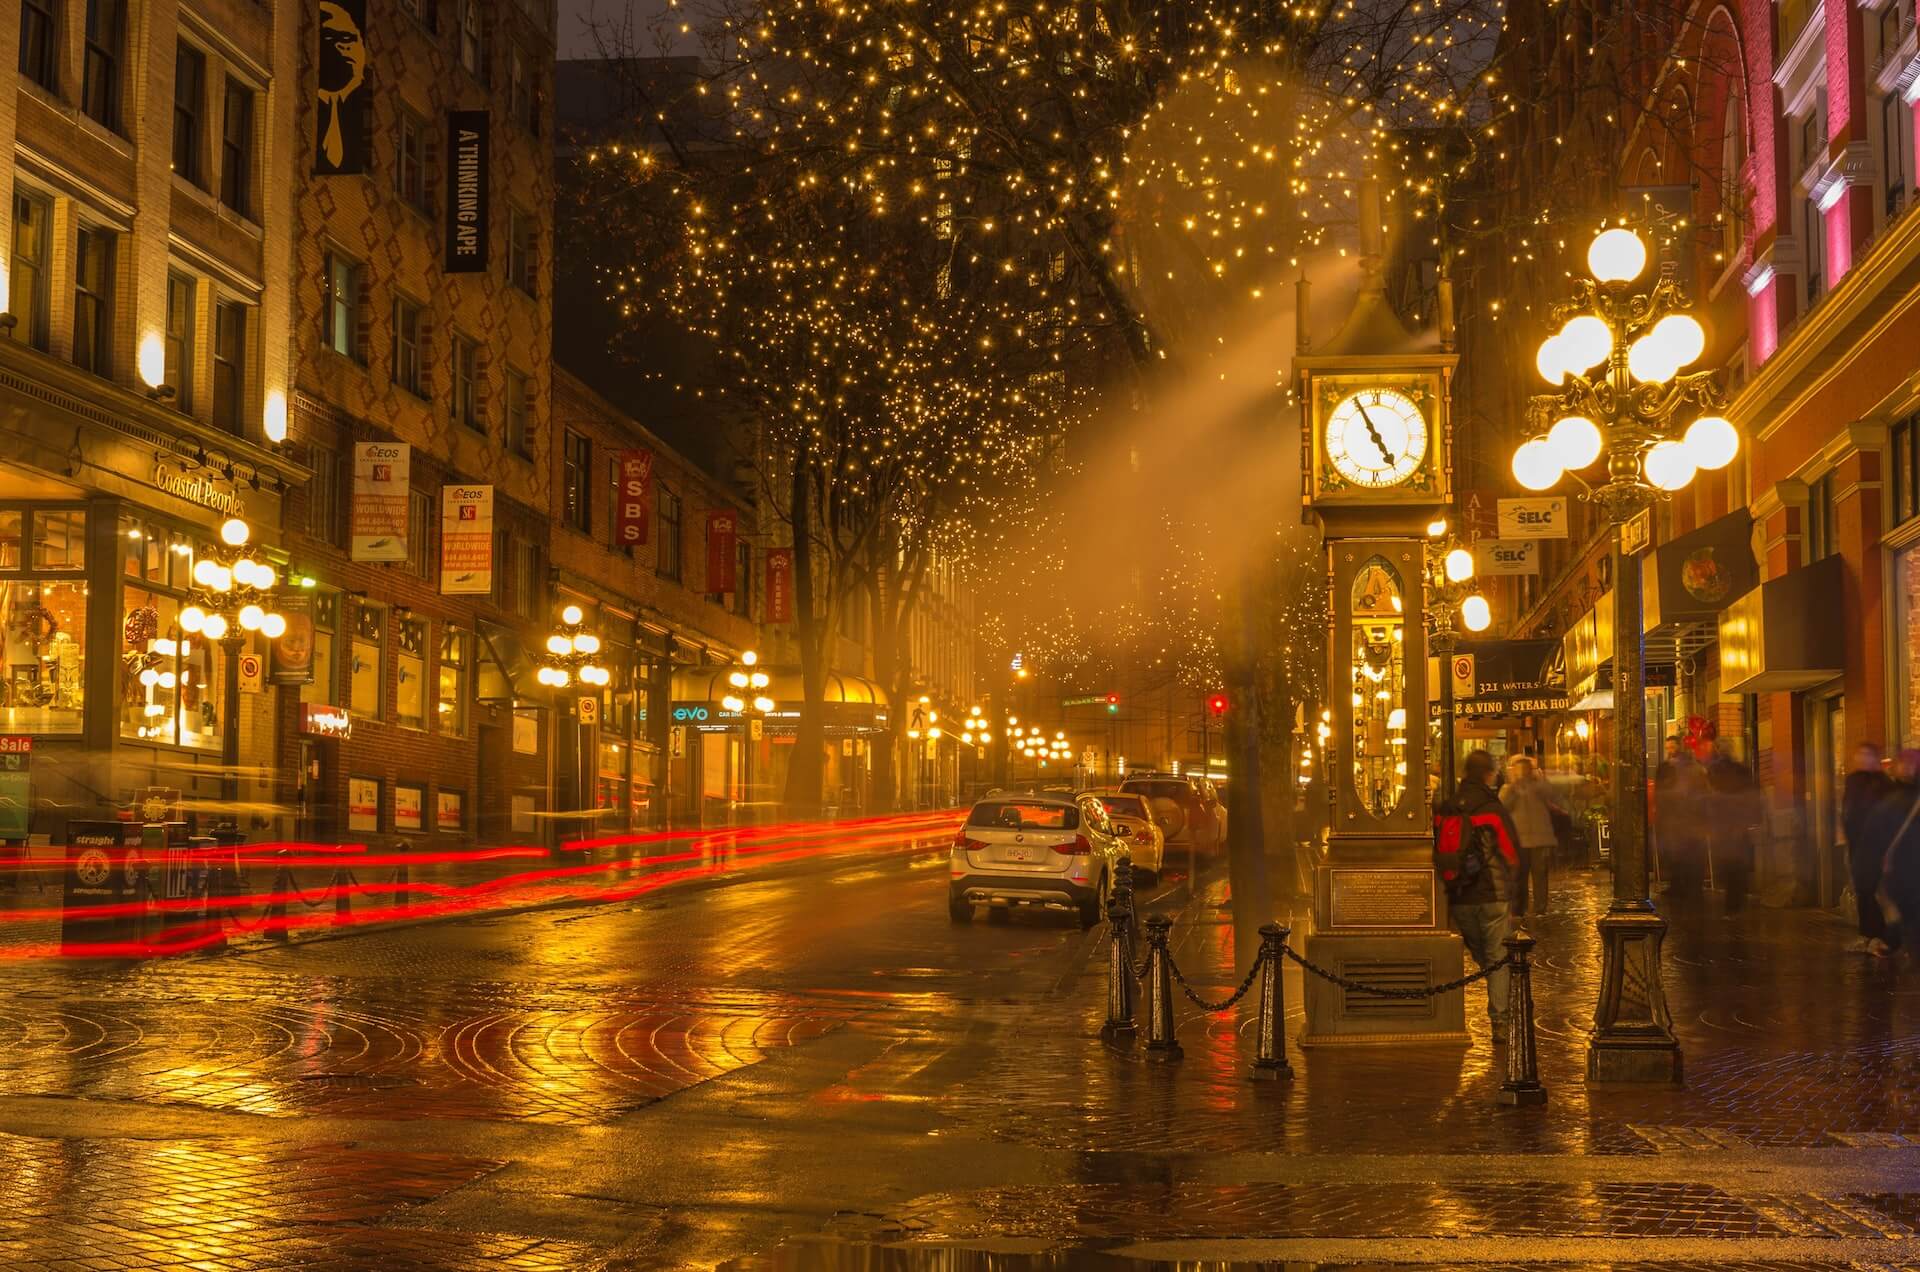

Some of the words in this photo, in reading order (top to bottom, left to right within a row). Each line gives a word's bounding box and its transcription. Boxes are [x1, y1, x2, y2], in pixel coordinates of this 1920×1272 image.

[459, 129, 479, 143] A
[457, 144, 479, 222] THINKING
[456, 224, 477, 256] APE
[156, 463, 202, 503] Coastal
[203, 481, 245, 519] Peoples
[1517, 511, 1552, 524] SELC
[1494, 550, 1526, 561] SELC
[1479, 682, 1498, 695] 321
[1502, 681, 1532, 690] WATER
[673, 706, 709, 721] evo
[1465, 702, 1474, 714] &
[1476, 701, 1503, 713] VINO
[1512, 700, 1548, 712] STEAK
[0, 738, 30, 752] Sale
[75, 836, 116, 846] straight
